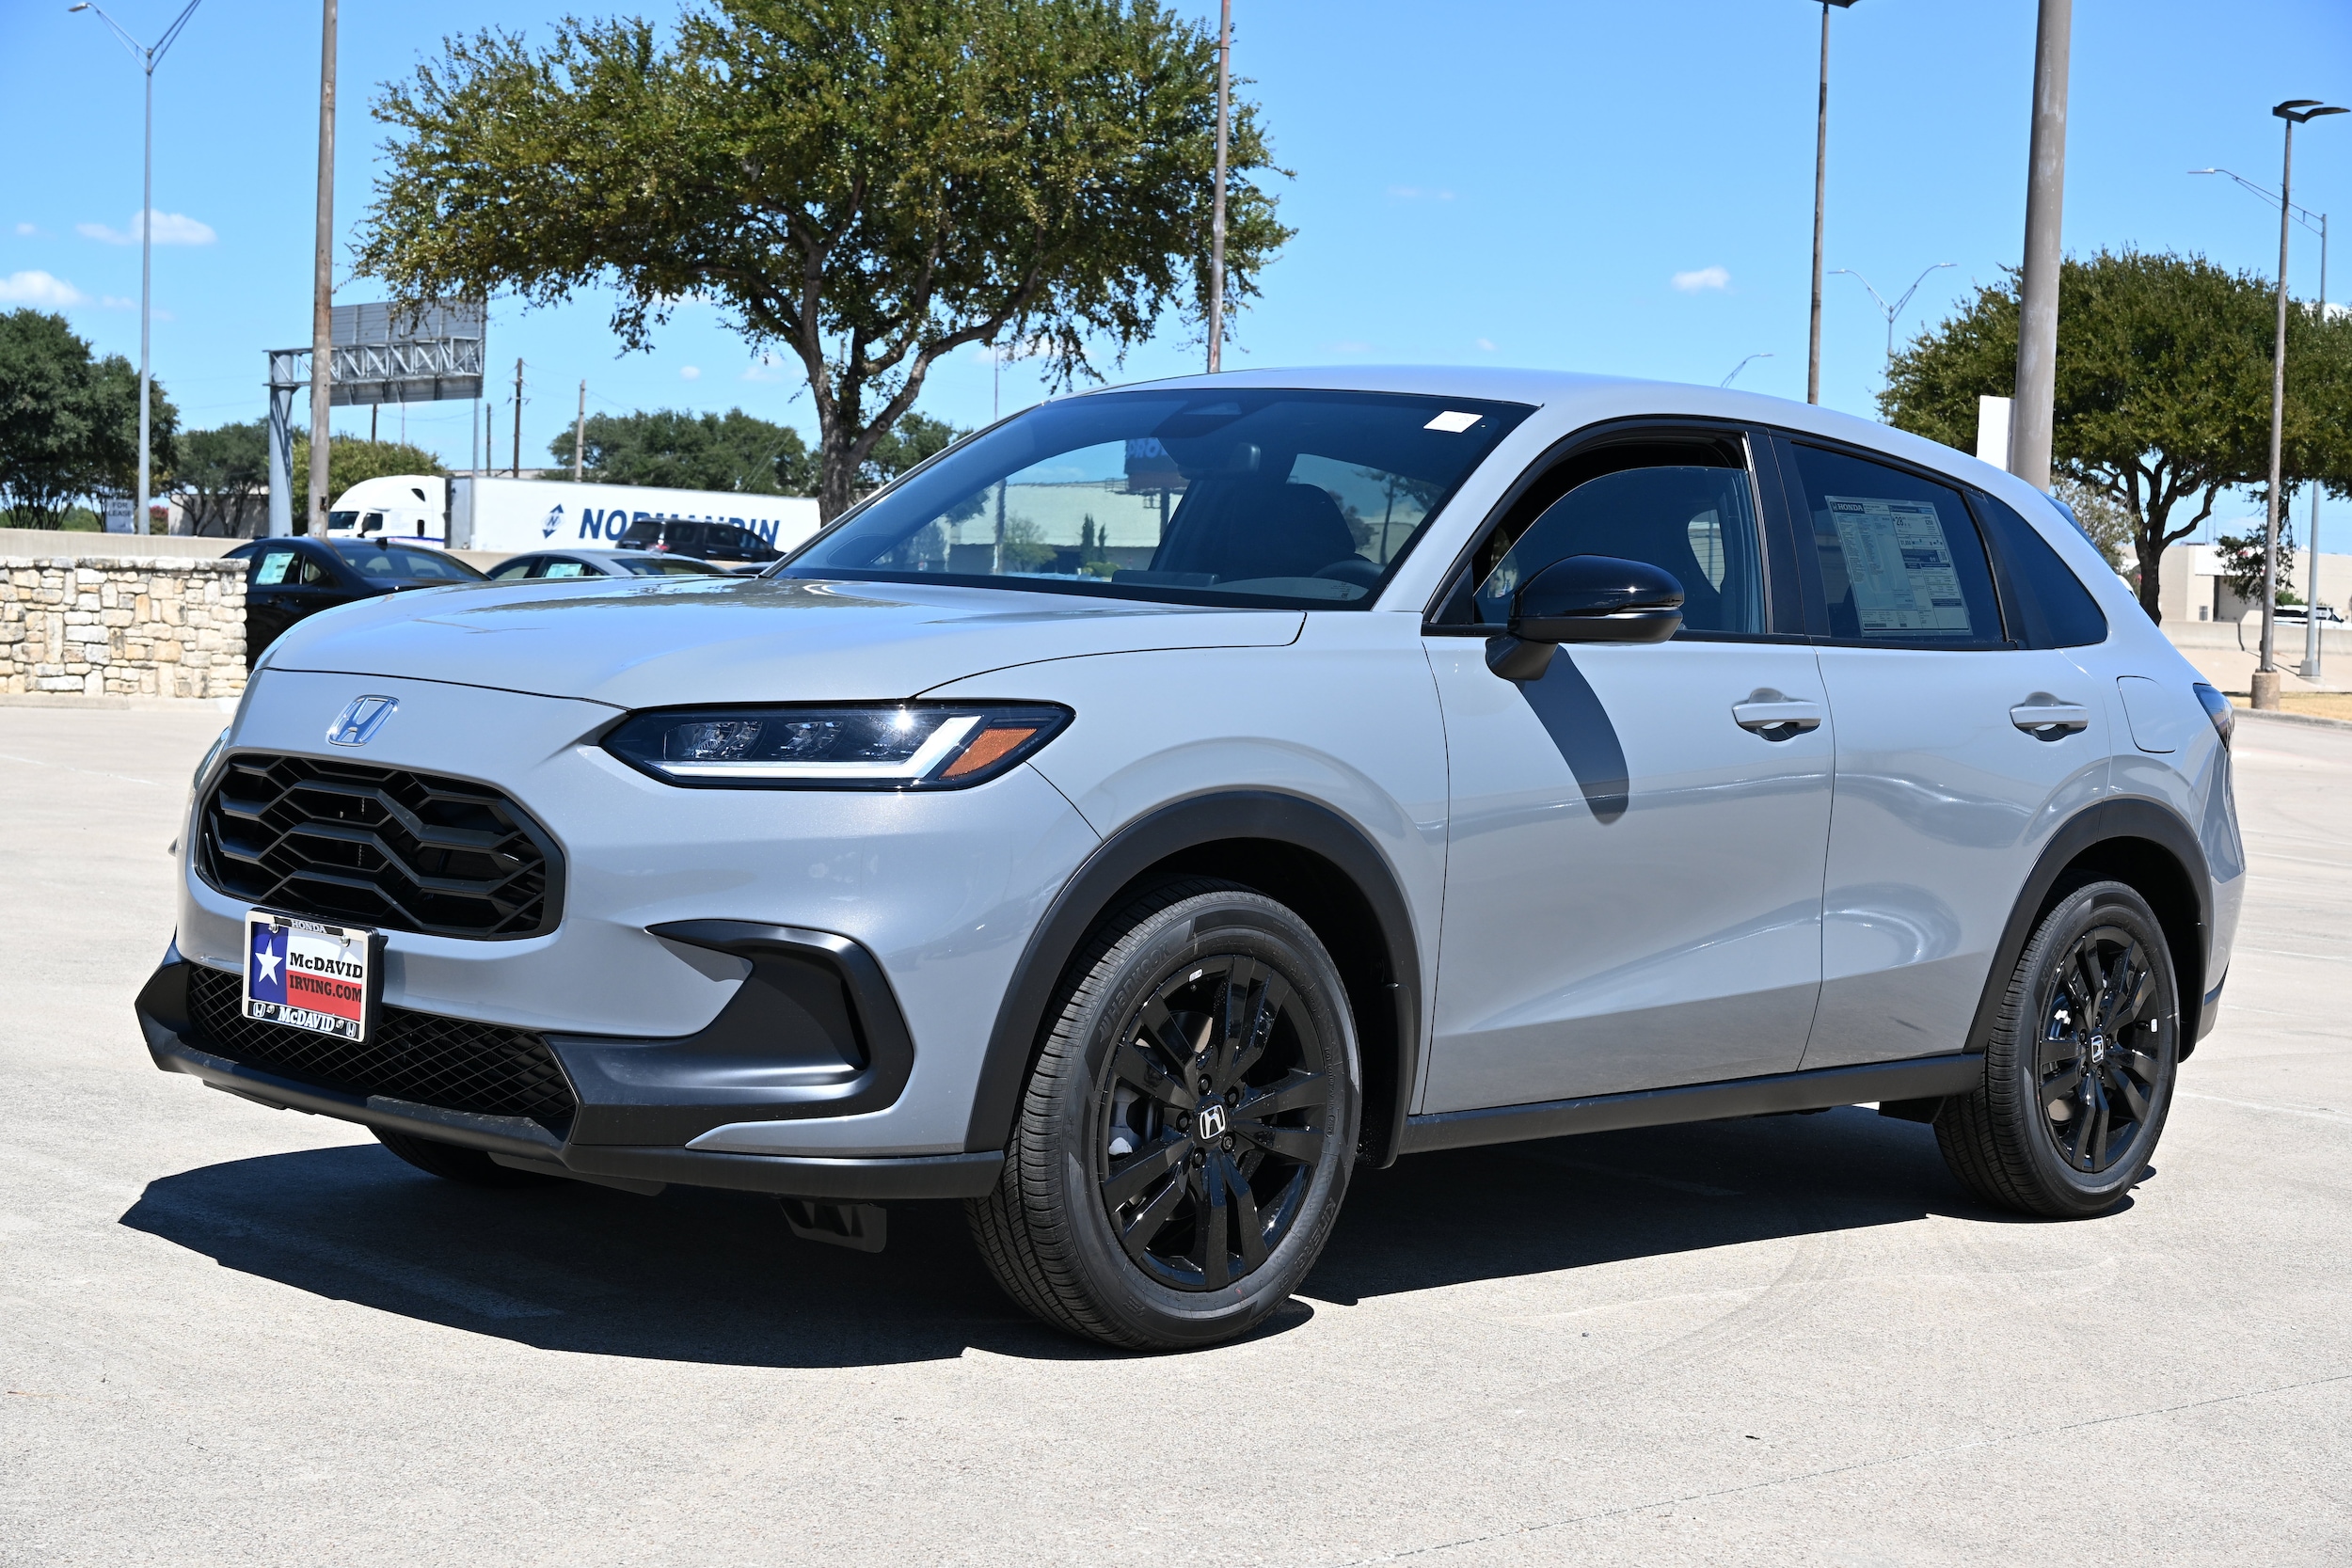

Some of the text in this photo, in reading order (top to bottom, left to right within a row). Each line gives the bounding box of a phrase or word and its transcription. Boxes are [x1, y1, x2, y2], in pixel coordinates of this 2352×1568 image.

[1837, 503, 1864, 512] HONDA
[291, 919, 327, 934] HONDA
[290, 952, 363, 979] McDAVID
[289, 974, 362, 1003] IRVING.COM
[278, 1006, 336, 1032] McDAVID
